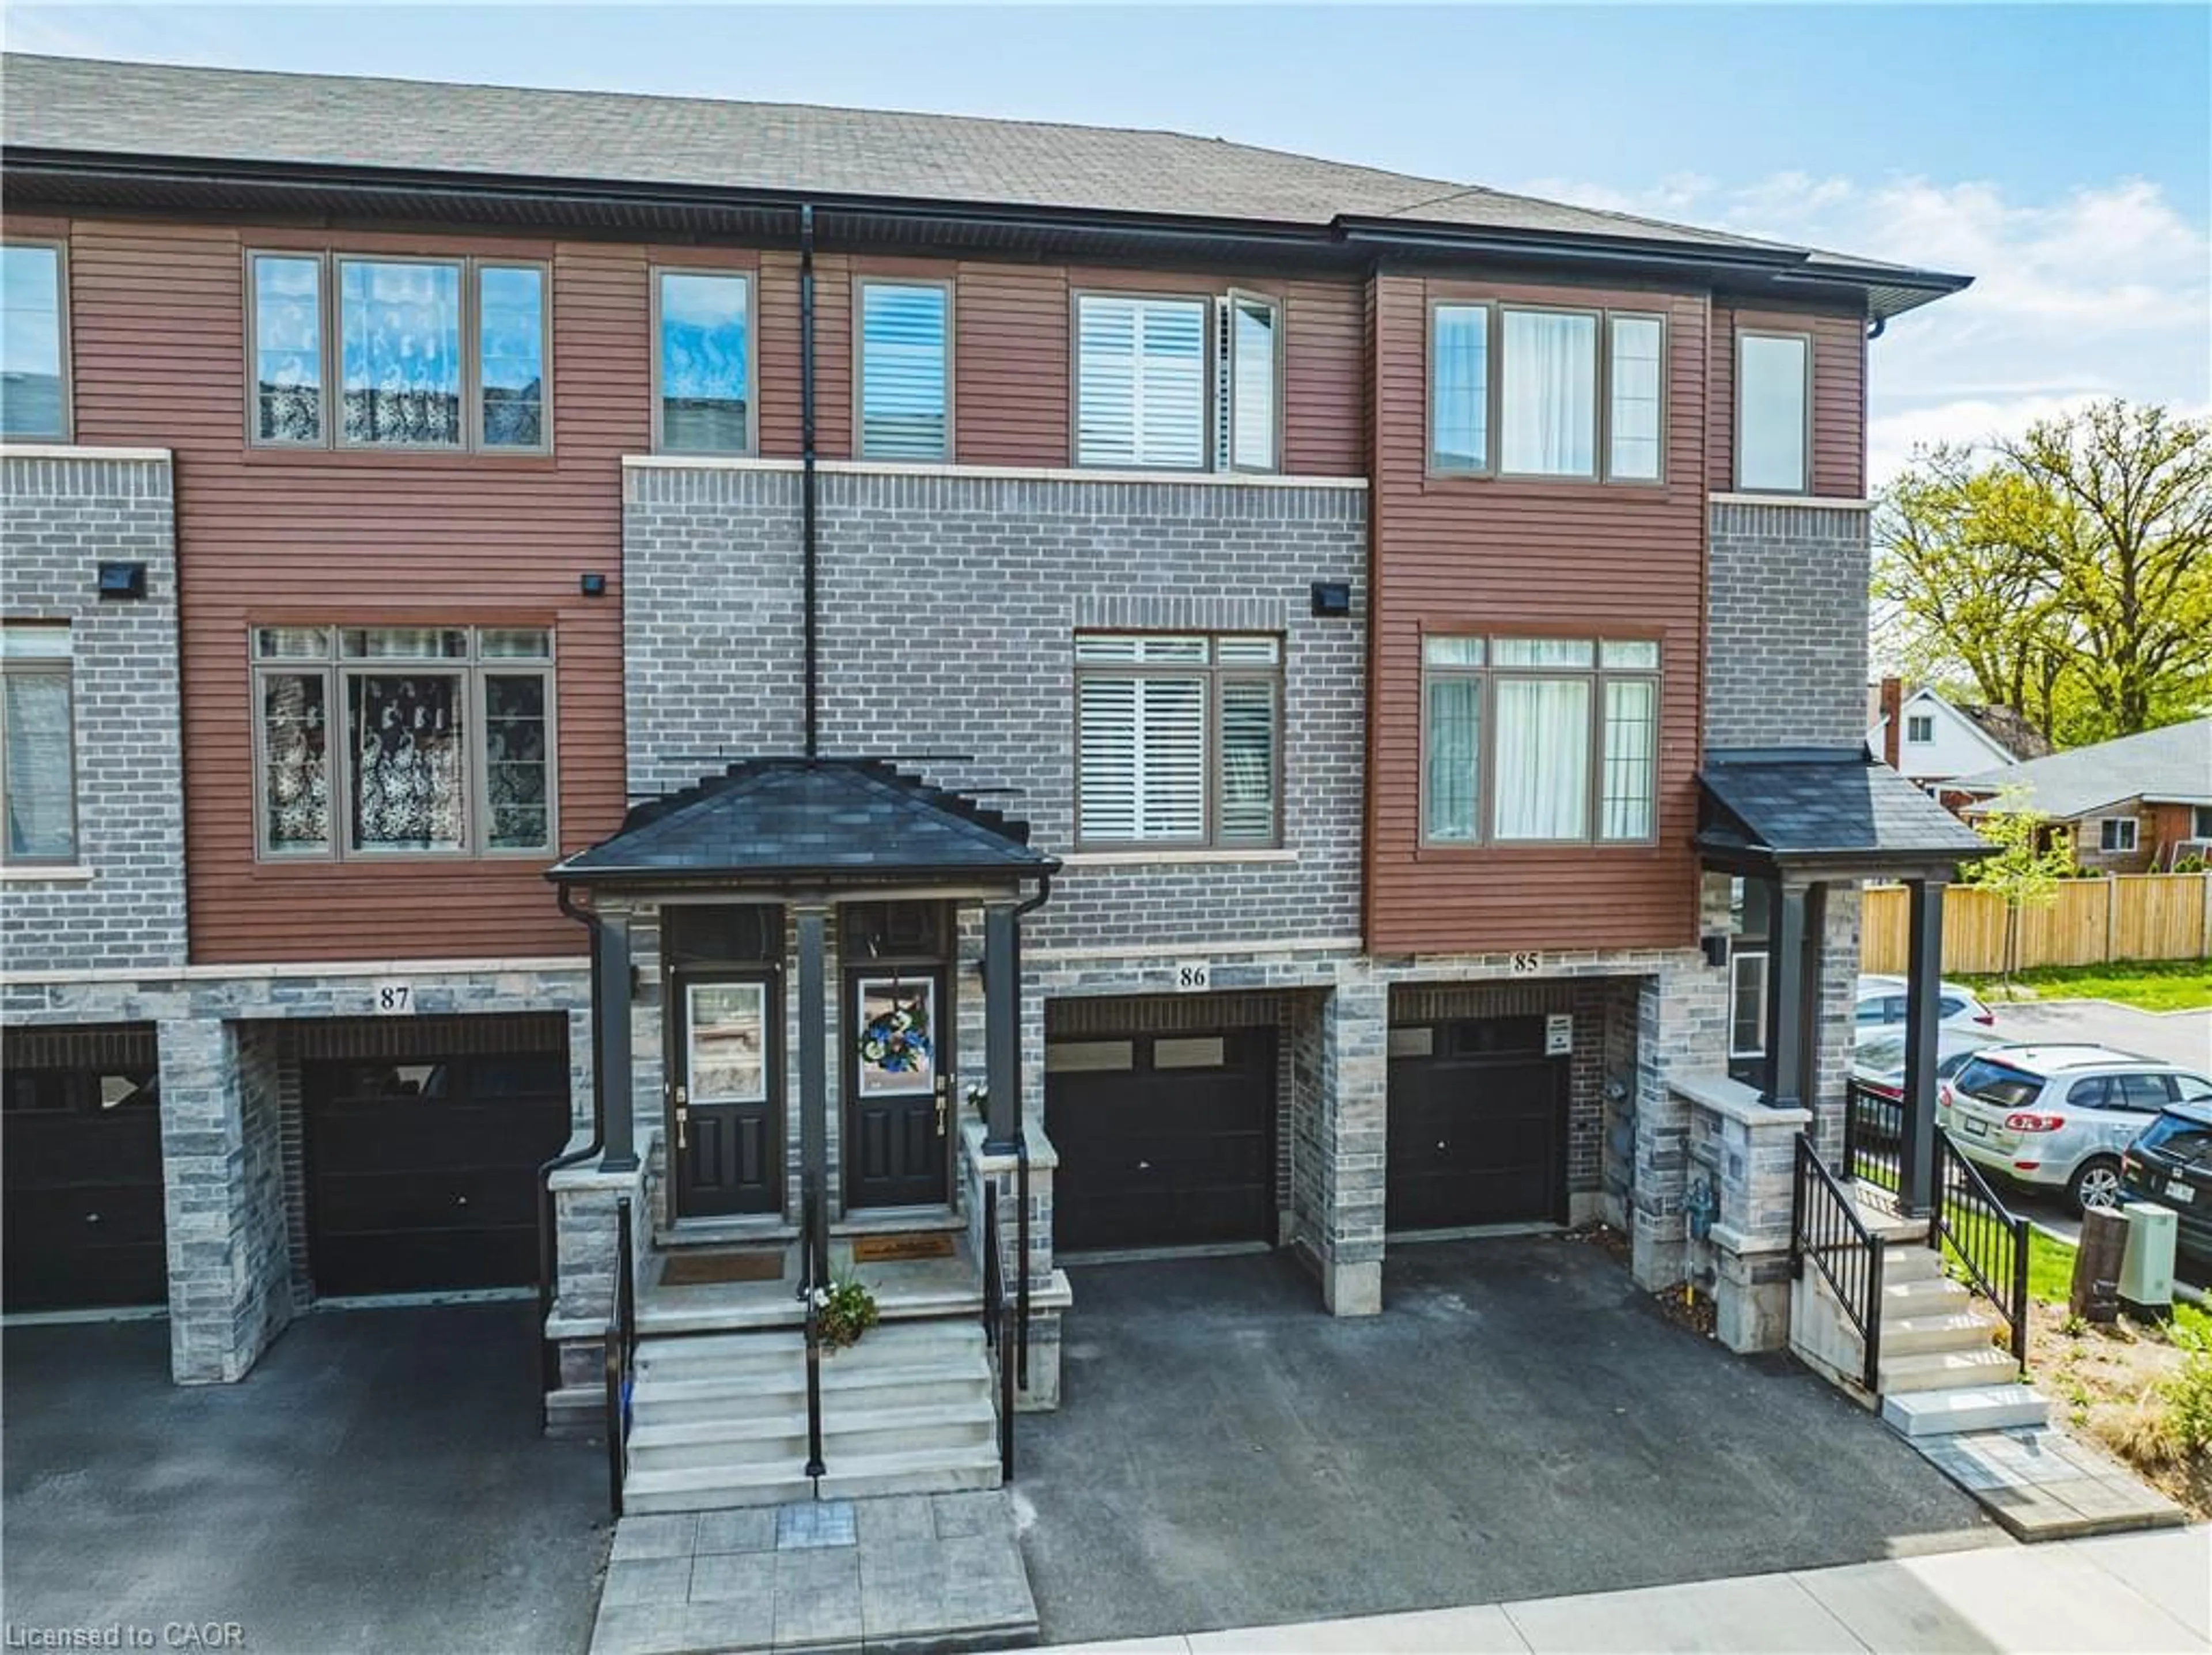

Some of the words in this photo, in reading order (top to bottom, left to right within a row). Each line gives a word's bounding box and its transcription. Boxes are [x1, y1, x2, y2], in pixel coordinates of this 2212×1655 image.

[1514, 952, 1538, 972] 85
[1181, 966, 1205, 986] 86
[381, 987, 408, 1009] 87
